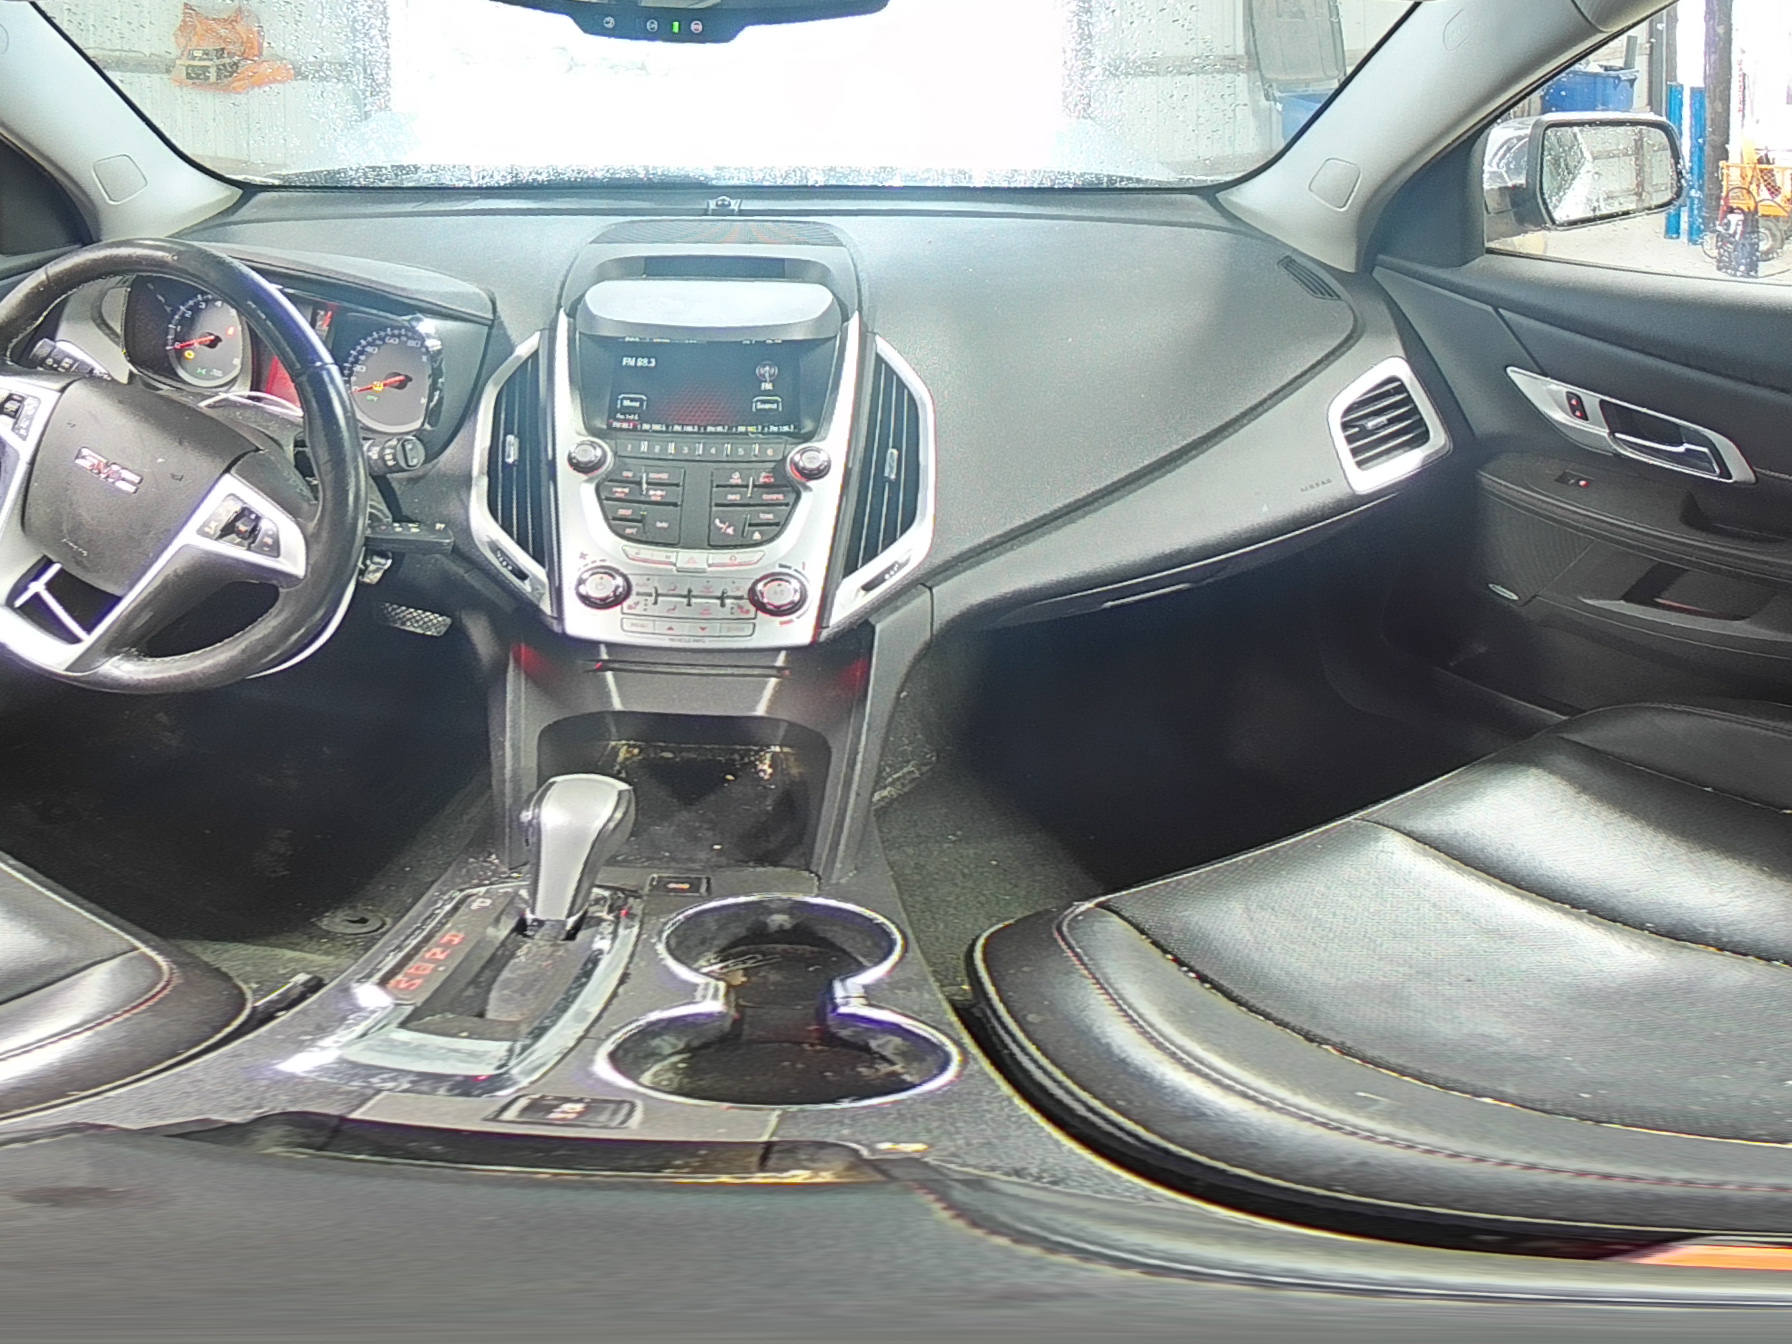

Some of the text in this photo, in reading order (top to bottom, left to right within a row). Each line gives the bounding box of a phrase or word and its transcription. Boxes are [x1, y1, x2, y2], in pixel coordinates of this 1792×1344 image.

[622, 357, 635, 367] FM
[74, 445, 144, 495] GMC
[470, 897, 492, 910] P
